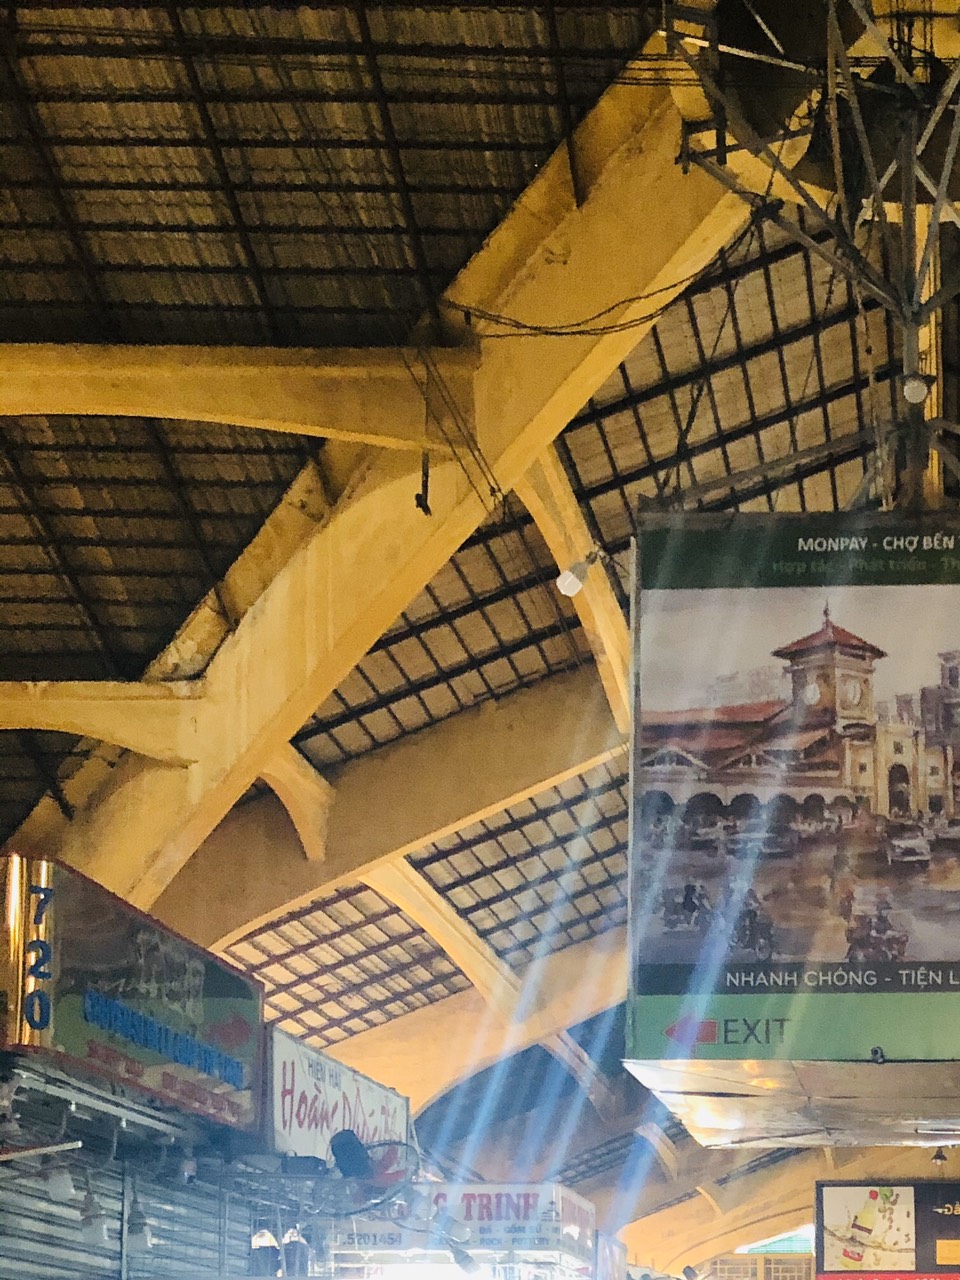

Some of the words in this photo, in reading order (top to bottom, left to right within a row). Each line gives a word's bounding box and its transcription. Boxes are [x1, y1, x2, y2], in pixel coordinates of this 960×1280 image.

[798, 537, 868, 551] MONPAY
[883, 535, 919, 552] CHỢ
[726, 971, 798, 987] NHANH
[803, 967, 878, 986] CHÓNG
[898, 966, 942, 989] TIỆN
[723, 1018, 791, 1045] EXIT
